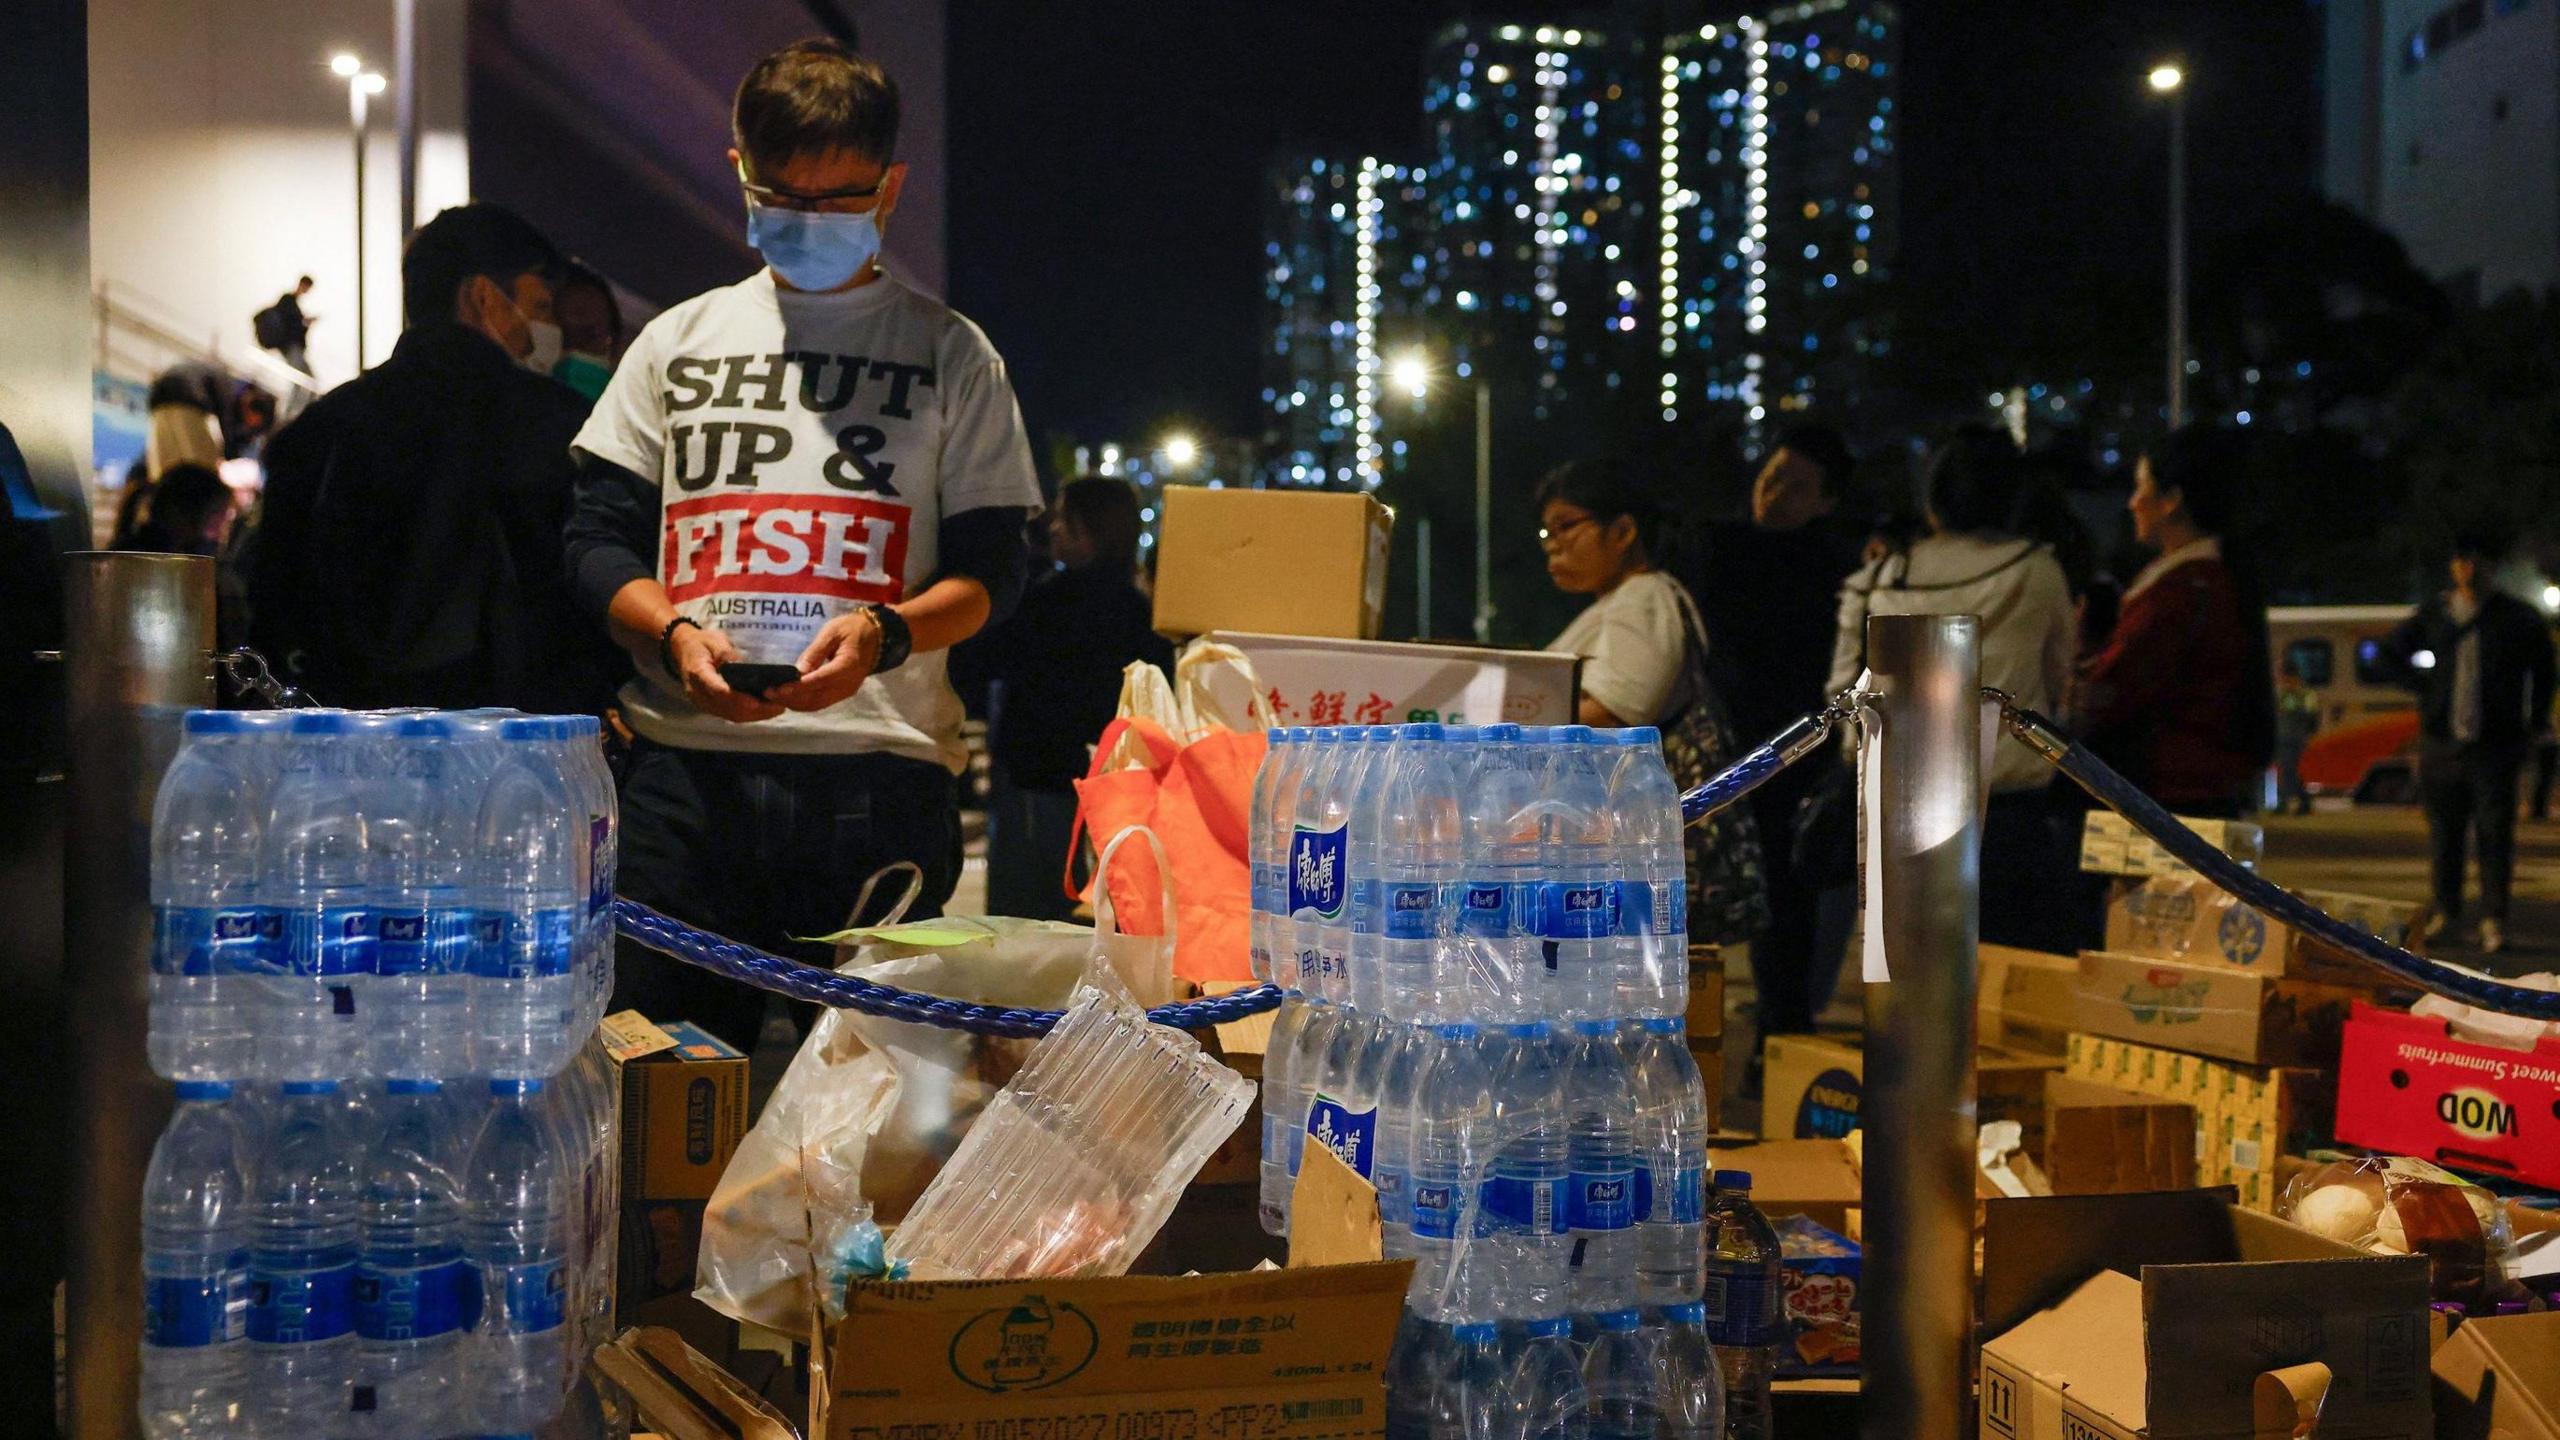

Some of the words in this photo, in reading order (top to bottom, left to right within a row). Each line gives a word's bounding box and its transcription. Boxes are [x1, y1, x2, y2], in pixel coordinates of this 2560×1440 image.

[664, 352, 936, 420] SHUT
[672, 422, 793, 491] UP
[823, 425, 900, 497] &
[672, 508, 896, 587] FISH
[707, 599, 826, 618] AUSTRALIA
[2397, 1043, 2508, 1081] Summerfruits
[2437, 1093, 2519, 1138] WOD
